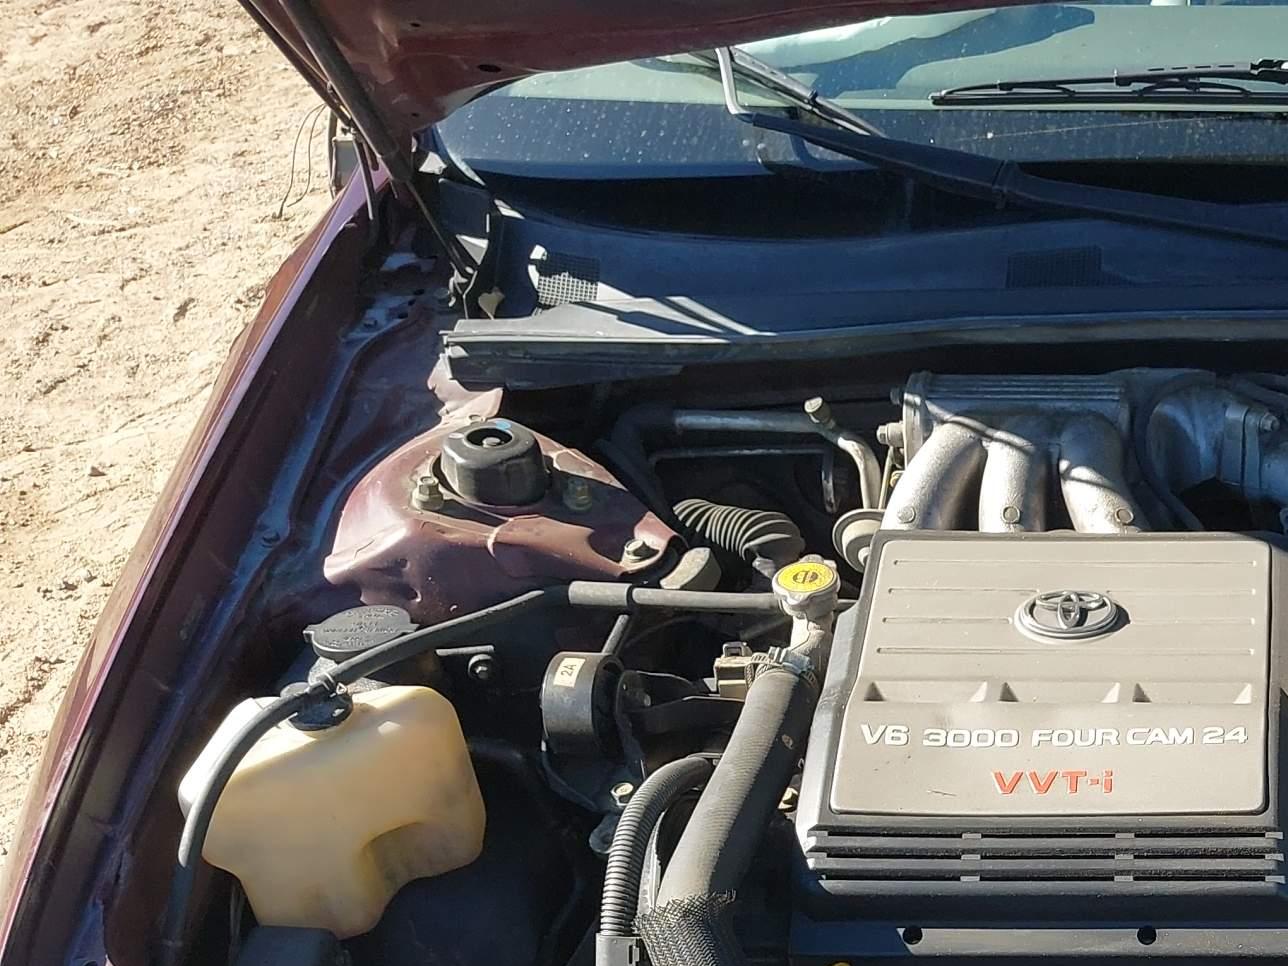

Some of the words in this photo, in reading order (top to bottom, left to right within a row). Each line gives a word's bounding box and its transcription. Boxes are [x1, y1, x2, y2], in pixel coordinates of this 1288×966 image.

[560, 664, 577, 677] 2A
[860, 723, 911, 746] V6
[922, 727, 1020, 748] 3000
[1031, 727, 1120, 747] FOUR
[1126, 726, 1195, 746] CAM
[1201, 726, 1249, 746] 24
[991, 768, 1114, 796] VVT-i
